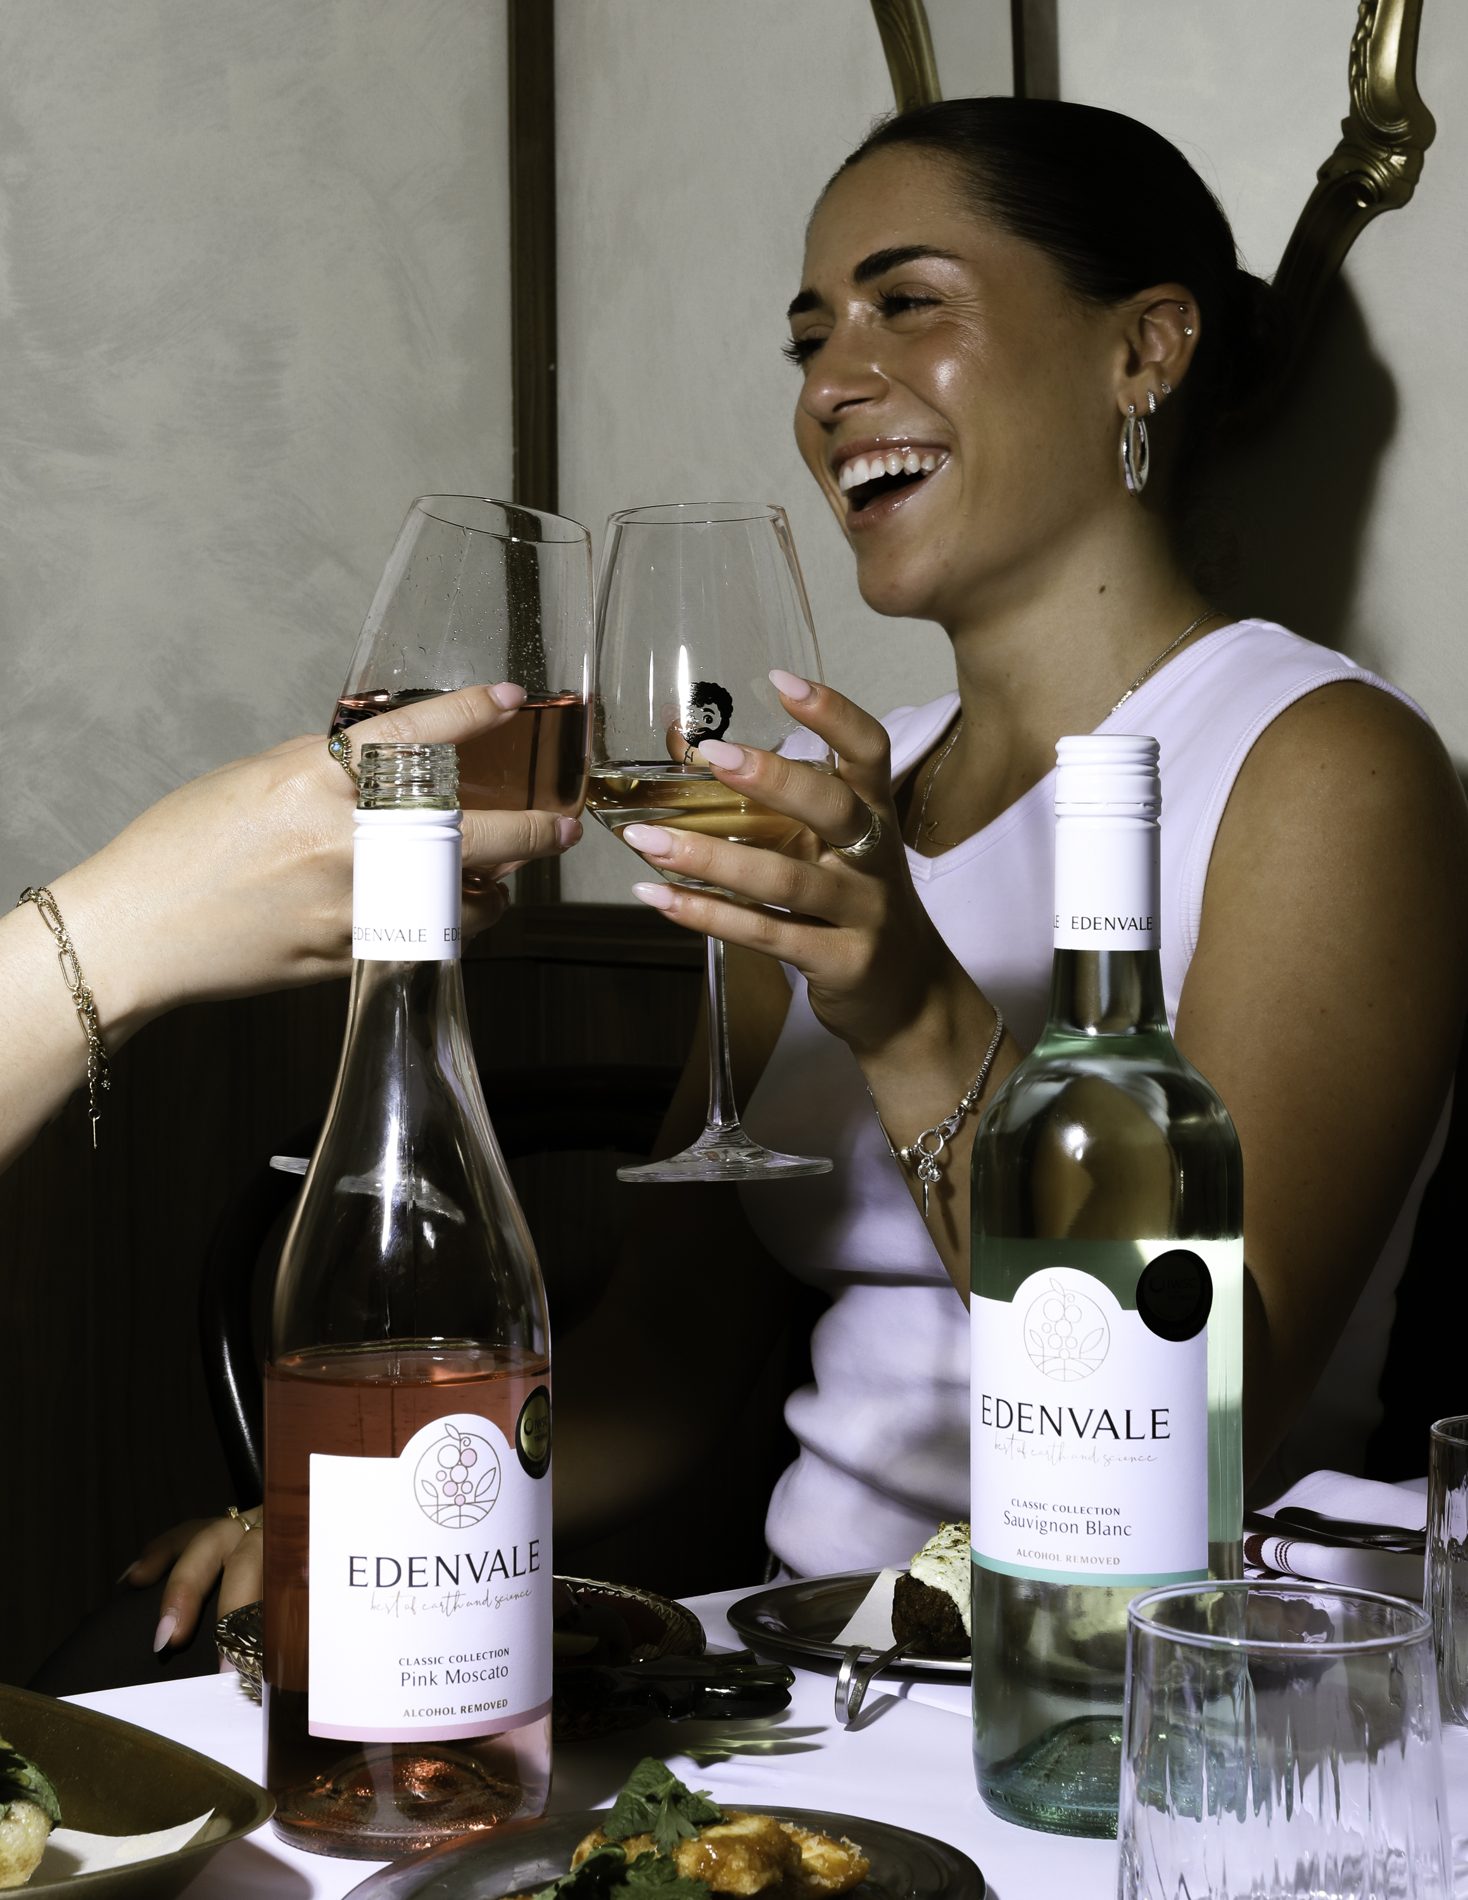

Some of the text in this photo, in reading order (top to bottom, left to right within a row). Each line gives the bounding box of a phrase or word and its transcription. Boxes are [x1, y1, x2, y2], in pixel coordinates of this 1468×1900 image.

[1071, 915, 1153, 931] EDENVALE
[353, 926, 428, 943] EDENVALE
[982, 1394, 1171, 1440] EDENVALE
[1011, 1498, 1121, 1516] CLASSIC COLLECTION
[1003, 1510, 1132, 1536] Sauvignon Blanc
[349, 1539, 540, 1588] EDENVALE
[1017, 1548, 1121, 1566] ALCOHOL REMOVED
[399, 1647, 510, 1667] CLASSIC COLLECTION
[401, 1665, 509, 1687] Pink Moscato
[403, 1698, 508, 1718] ALCOHOL REMOVED
